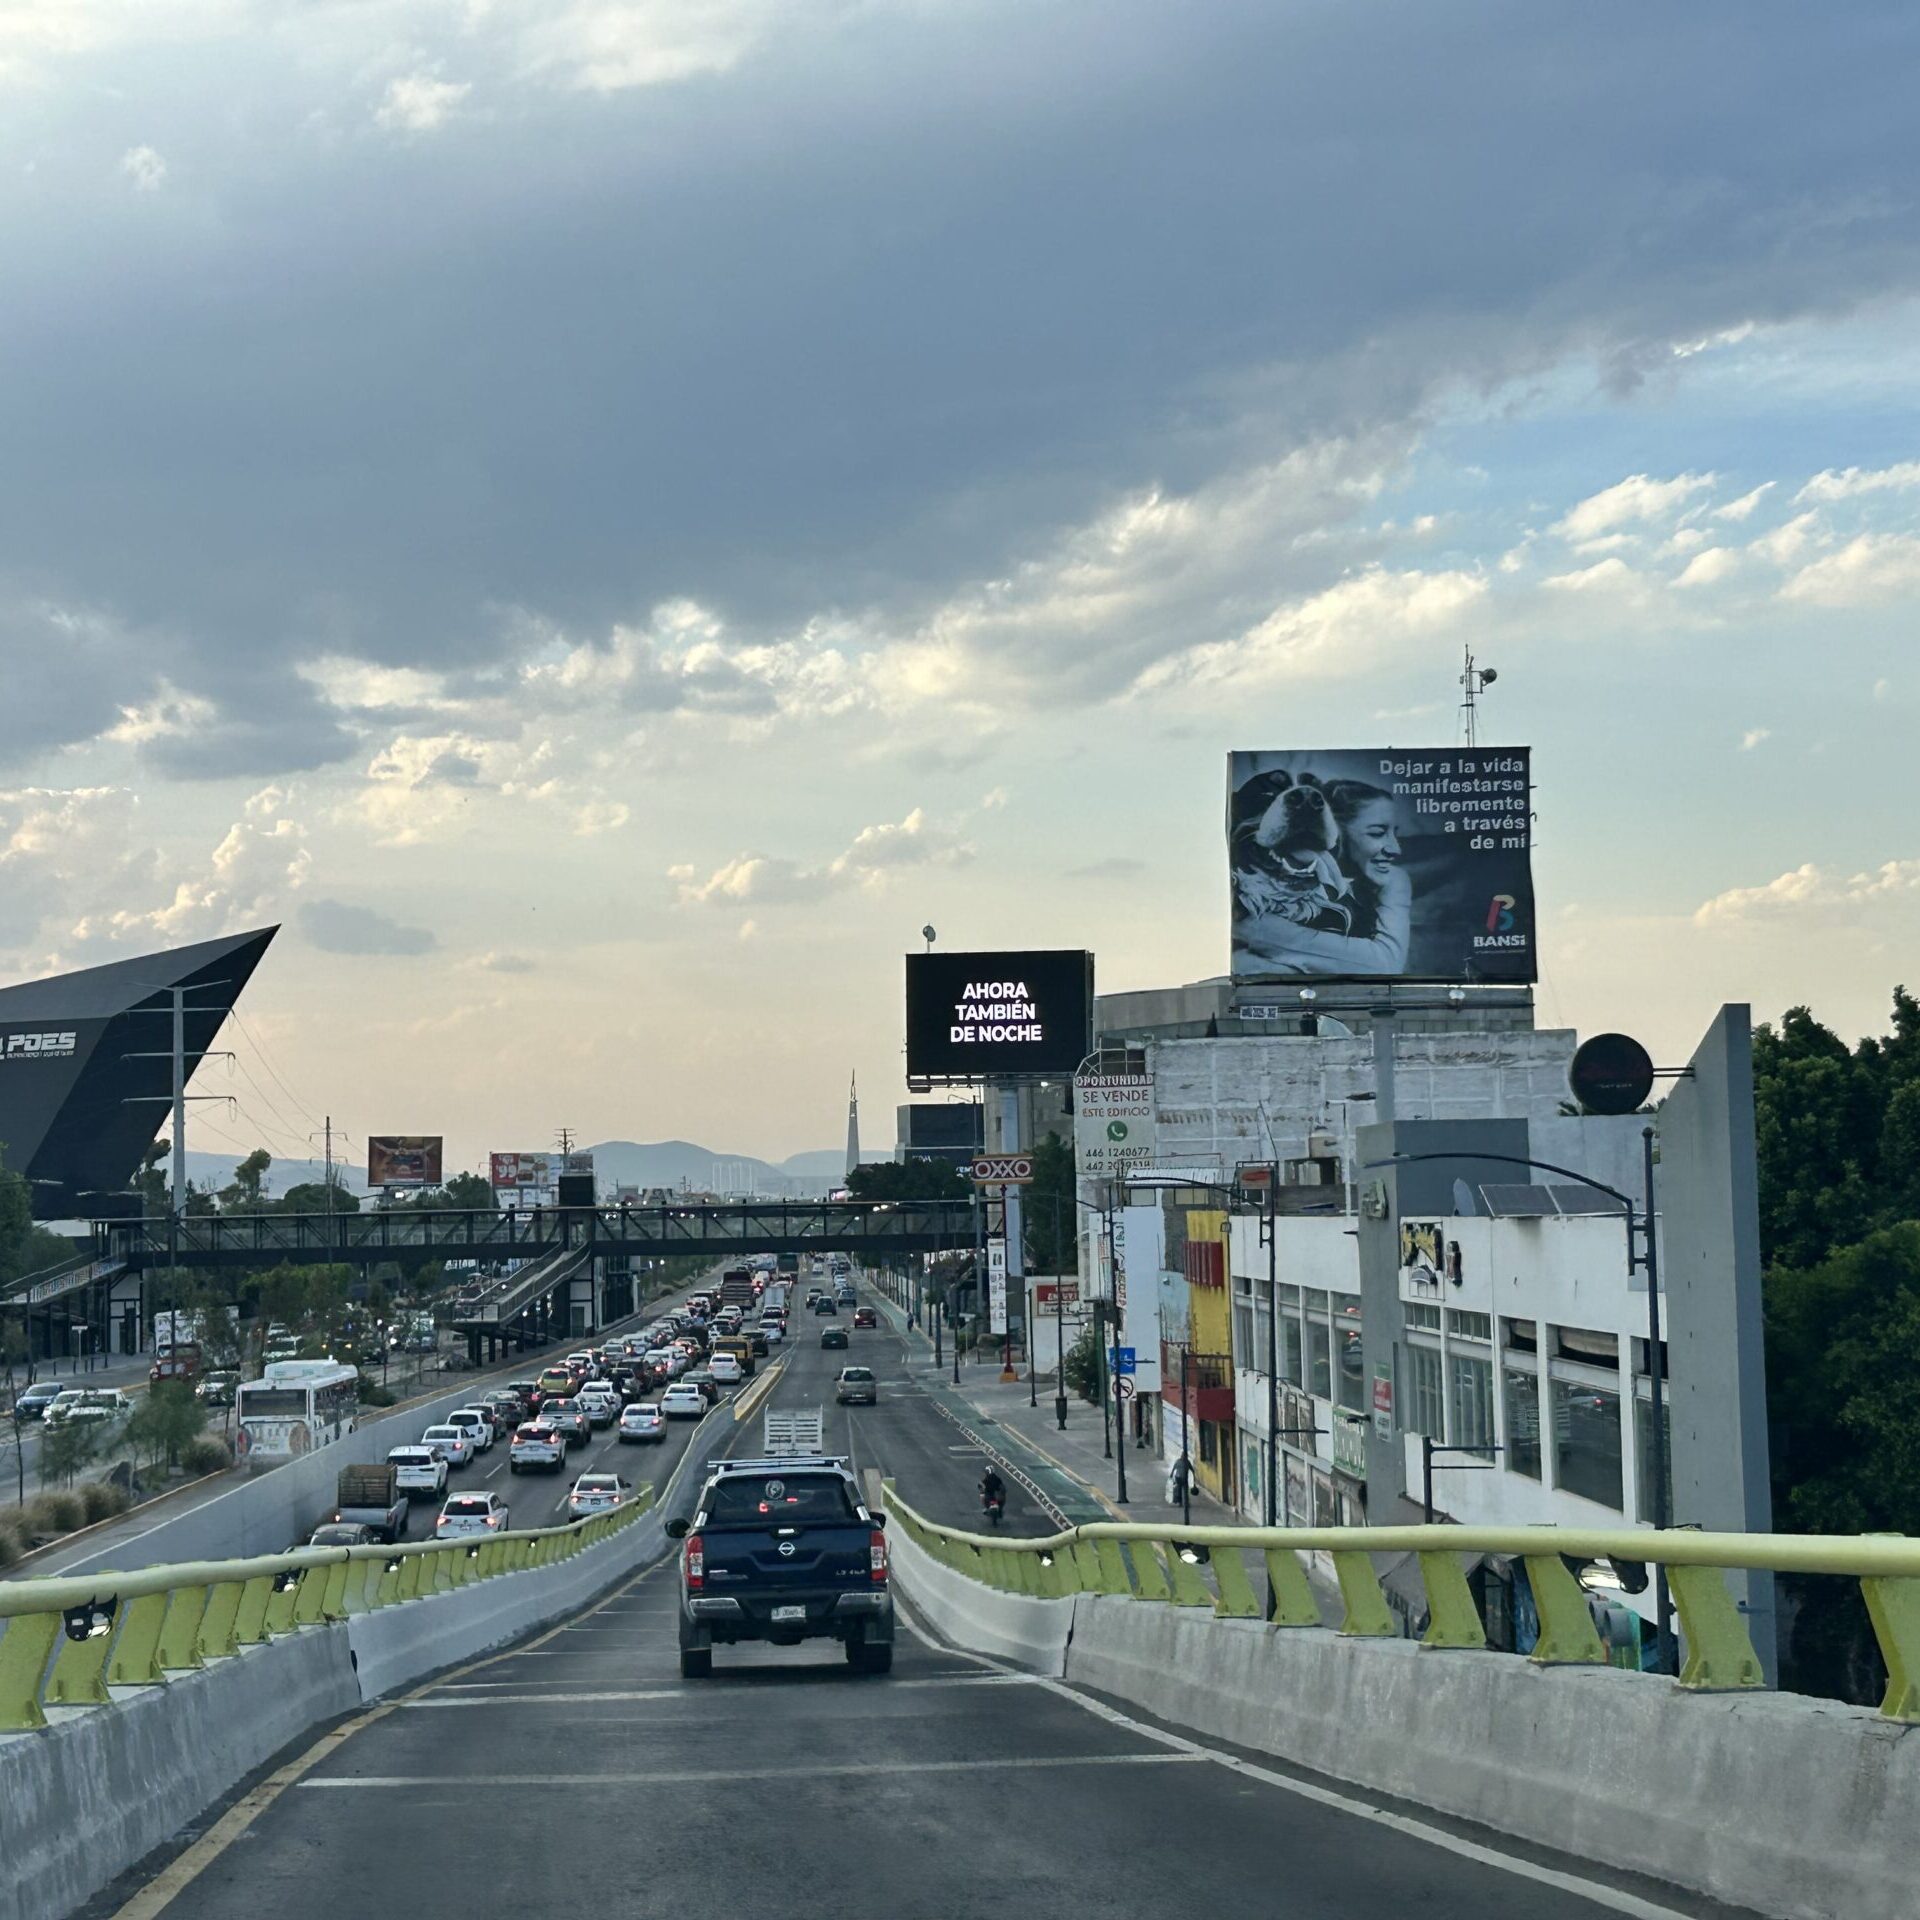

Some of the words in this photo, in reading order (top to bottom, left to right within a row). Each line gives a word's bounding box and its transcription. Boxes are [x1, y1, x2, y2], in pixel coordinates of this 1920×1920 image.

[1380, 760, 1433, 777] Dejar
[1439, 762, 1450, 774] a
[1458, 759, 1475, 773] la
[1483, 758, 1524, 772] vida
[1392, 778, 1524, 794] manifestarse
[1416, 798, 1525, 813] libremente
[1444, 820, 1455, 832] a
[1462, 815, 1525, 830] través
[1470, 835, 1494, 849] de
[962, 982, 1028, 999] AHORA
[955, 1000, 1035, 1020] TAMBIÉN
[950, 1026, 975, 1042] DE
[979, 1025, 1042, 1042] NOCHE
[1075, 1075, 1153, 1087] OPORTUNIDAD
[1083, 1091, 1098, 1103] SE
[1102, 1090, 1149, 1102] VENDE
[1083, 1108, 1104, 1117] ESTE
[1107, 1107, 1150, 1117] EDIFICIO
[1086, 1149, 1104, 1157] 446
[1108, 1147, 1149, 1157] 1240677
[975, 1160, 1030, 1178] OXXO
